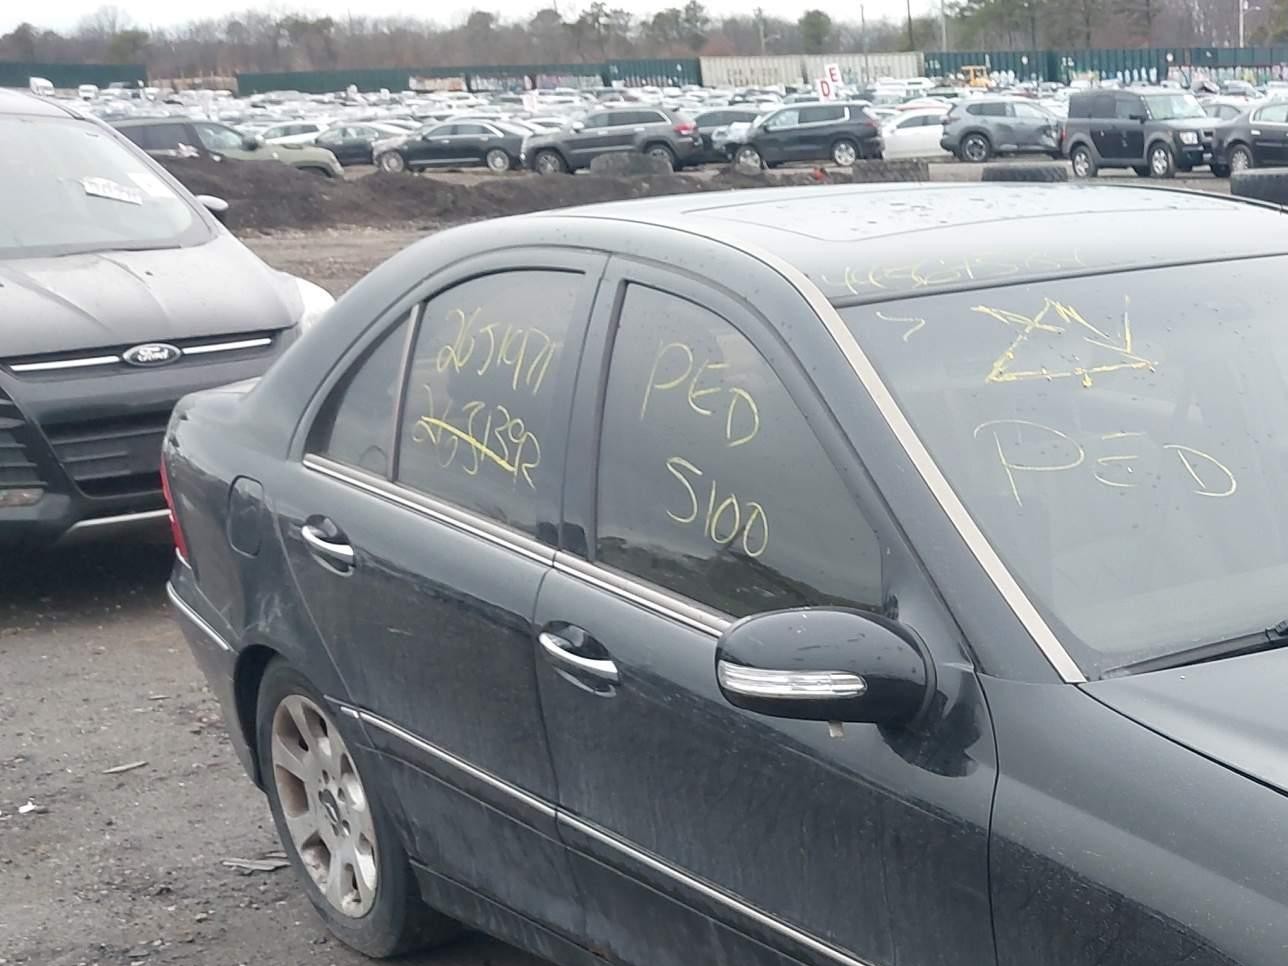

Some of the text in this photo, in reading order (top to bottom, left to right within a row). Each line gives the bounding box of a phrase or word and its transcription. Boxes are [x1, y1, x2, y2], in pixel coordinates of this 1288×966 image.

[820, 80, 830, 97] D
[829, 67, 839, 82] E
[640, 340, 760, 447] PED
[973, 419, 1237, 507] PED
